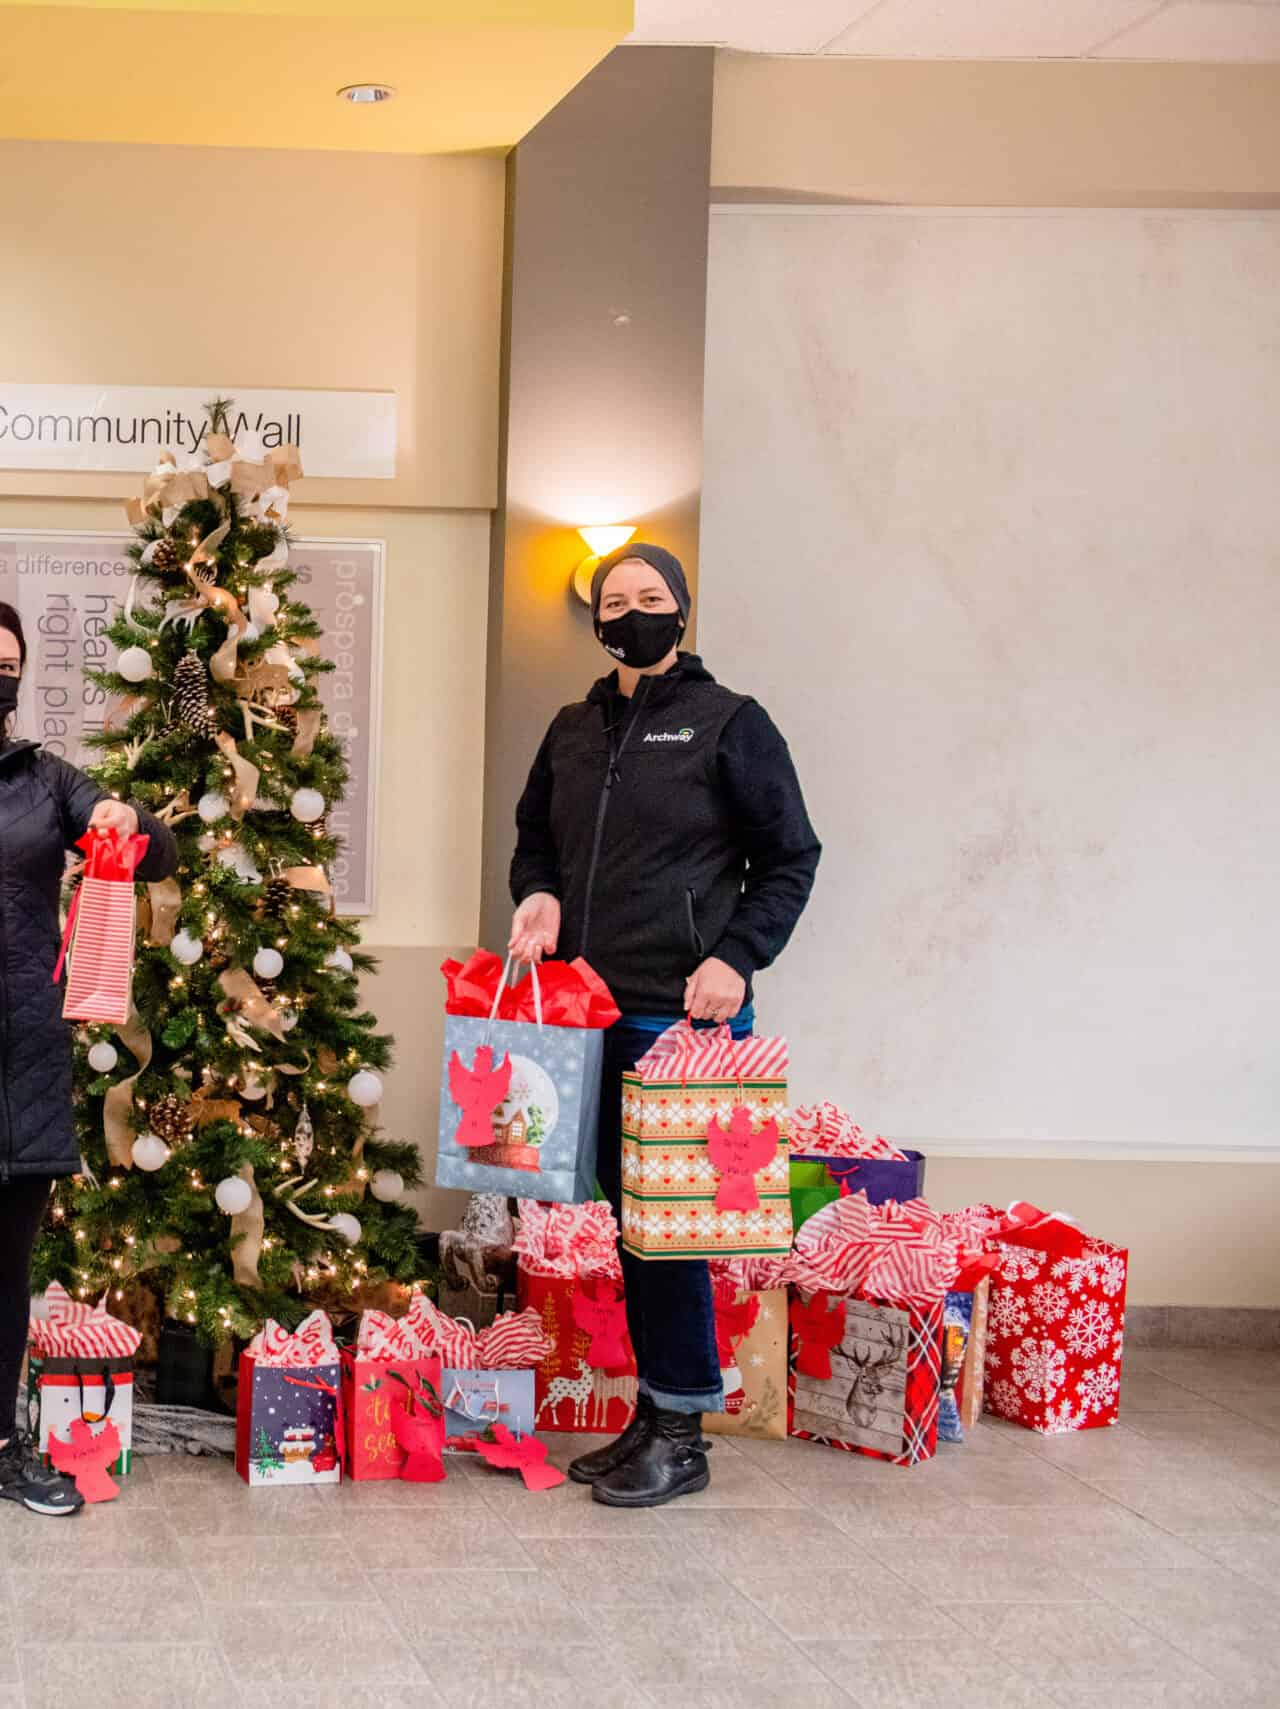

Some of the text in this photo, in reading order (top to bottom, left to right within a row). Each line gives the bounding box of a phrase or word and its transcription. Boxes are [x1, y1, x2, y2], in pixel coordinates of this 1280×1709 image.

[219, 412, 301, 449] Wall
[16, 553, 127, 576] difference
[82, 594, 115, 706] hears
[330, 559, 360, 699] prospera
[37, 593, 78, 756] right plac
[643, 730, 694, 743] Archway
